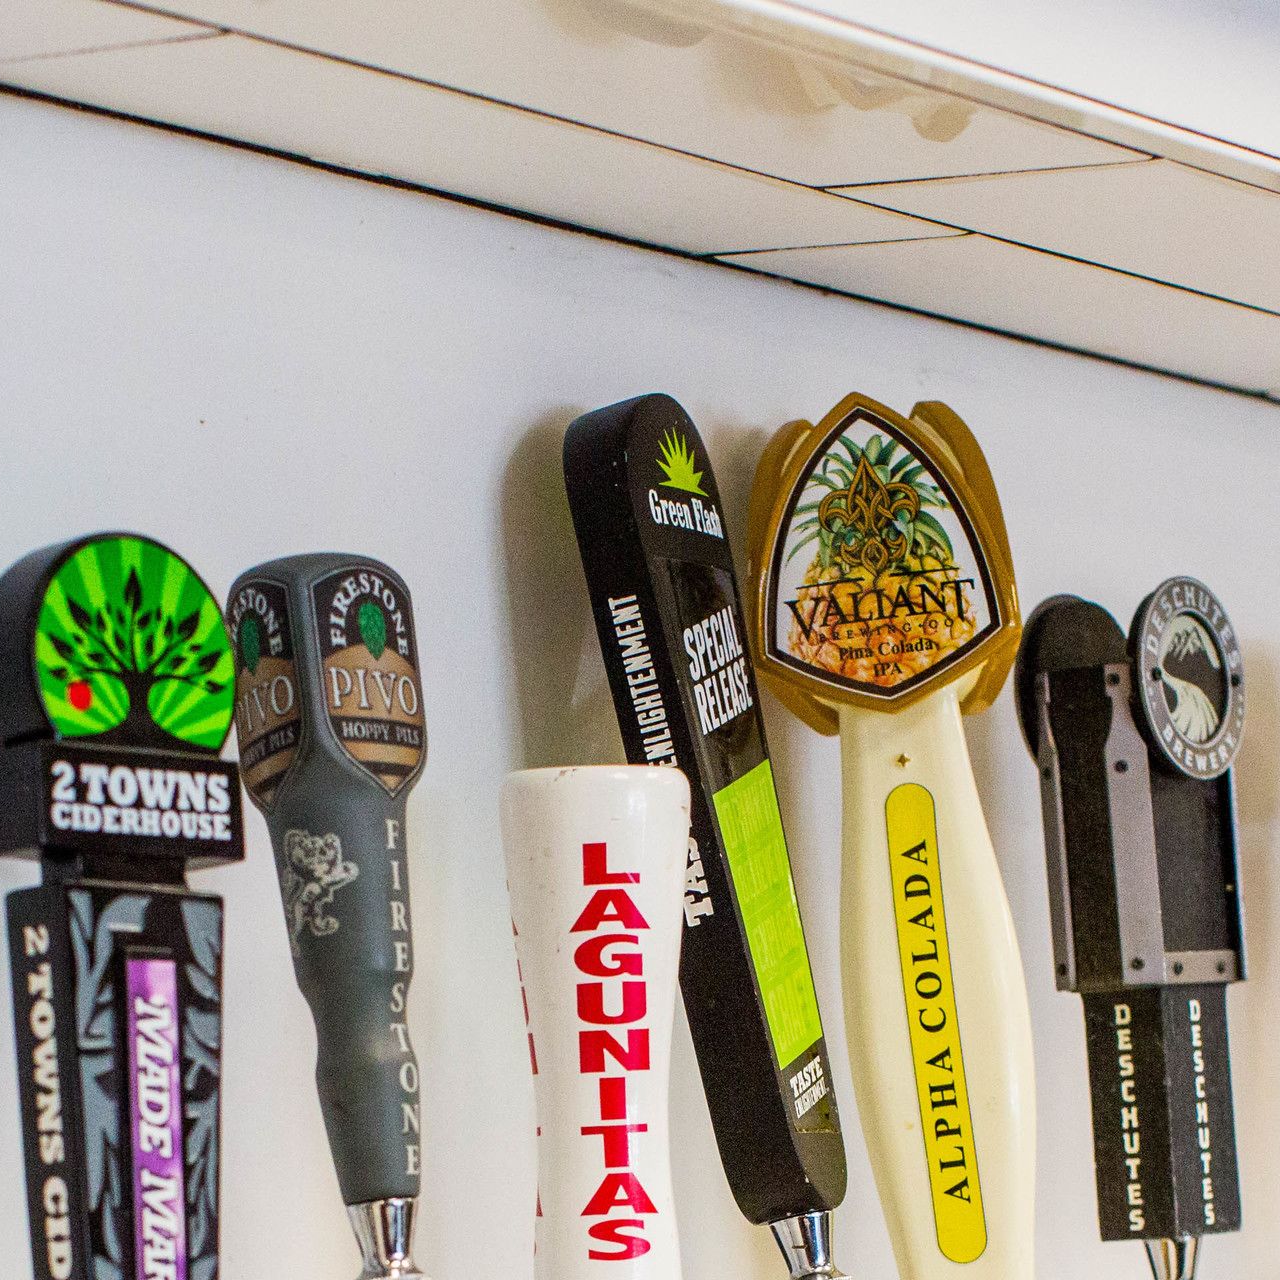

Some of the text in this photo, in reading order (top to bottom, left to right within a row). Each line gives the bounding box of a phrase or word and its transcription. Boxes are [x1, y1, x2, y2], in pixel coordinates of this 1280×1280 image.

[648, 489, 724, 539] Green Flash
[329, 572, 410, 657] FIRESTONE
[683, 605, 743, 682] SPECIAL
[783, 578, 975, 641] VALIANT
[1146, 585, 1241, 669] DESCHUTES
[873, 663, 903, 678] IPA
[878, 637, 934, 656] Colada
[328, 667, 418, 716] PIVO
[693, 657, 753, 736] RELEASE
[341, 721, 389, 741] HOPPY
[1162, 723, 1237, 772] BREWERY
[50, 759, 231, 814] 2 TOWNS
[50, 802, 233, 841] CIDERHOUSE
[23, 924, 50, 957] 2
[385, 818, 419, 1176] FIRESTONE
[900, 839, 971, 1204] ALPHA COLADA
[28, 963, 66, 1164] TOWNS
[135, 996, 175, 1159] MADE
[569, 842, 659, 1261] LAGUNITAS
[789, 1054, 824, 1099] TASTE
[1114, 1003, 1145, 1232] DESCHUTES
[1188, 999, 1215, 1226] DESCHUTES
